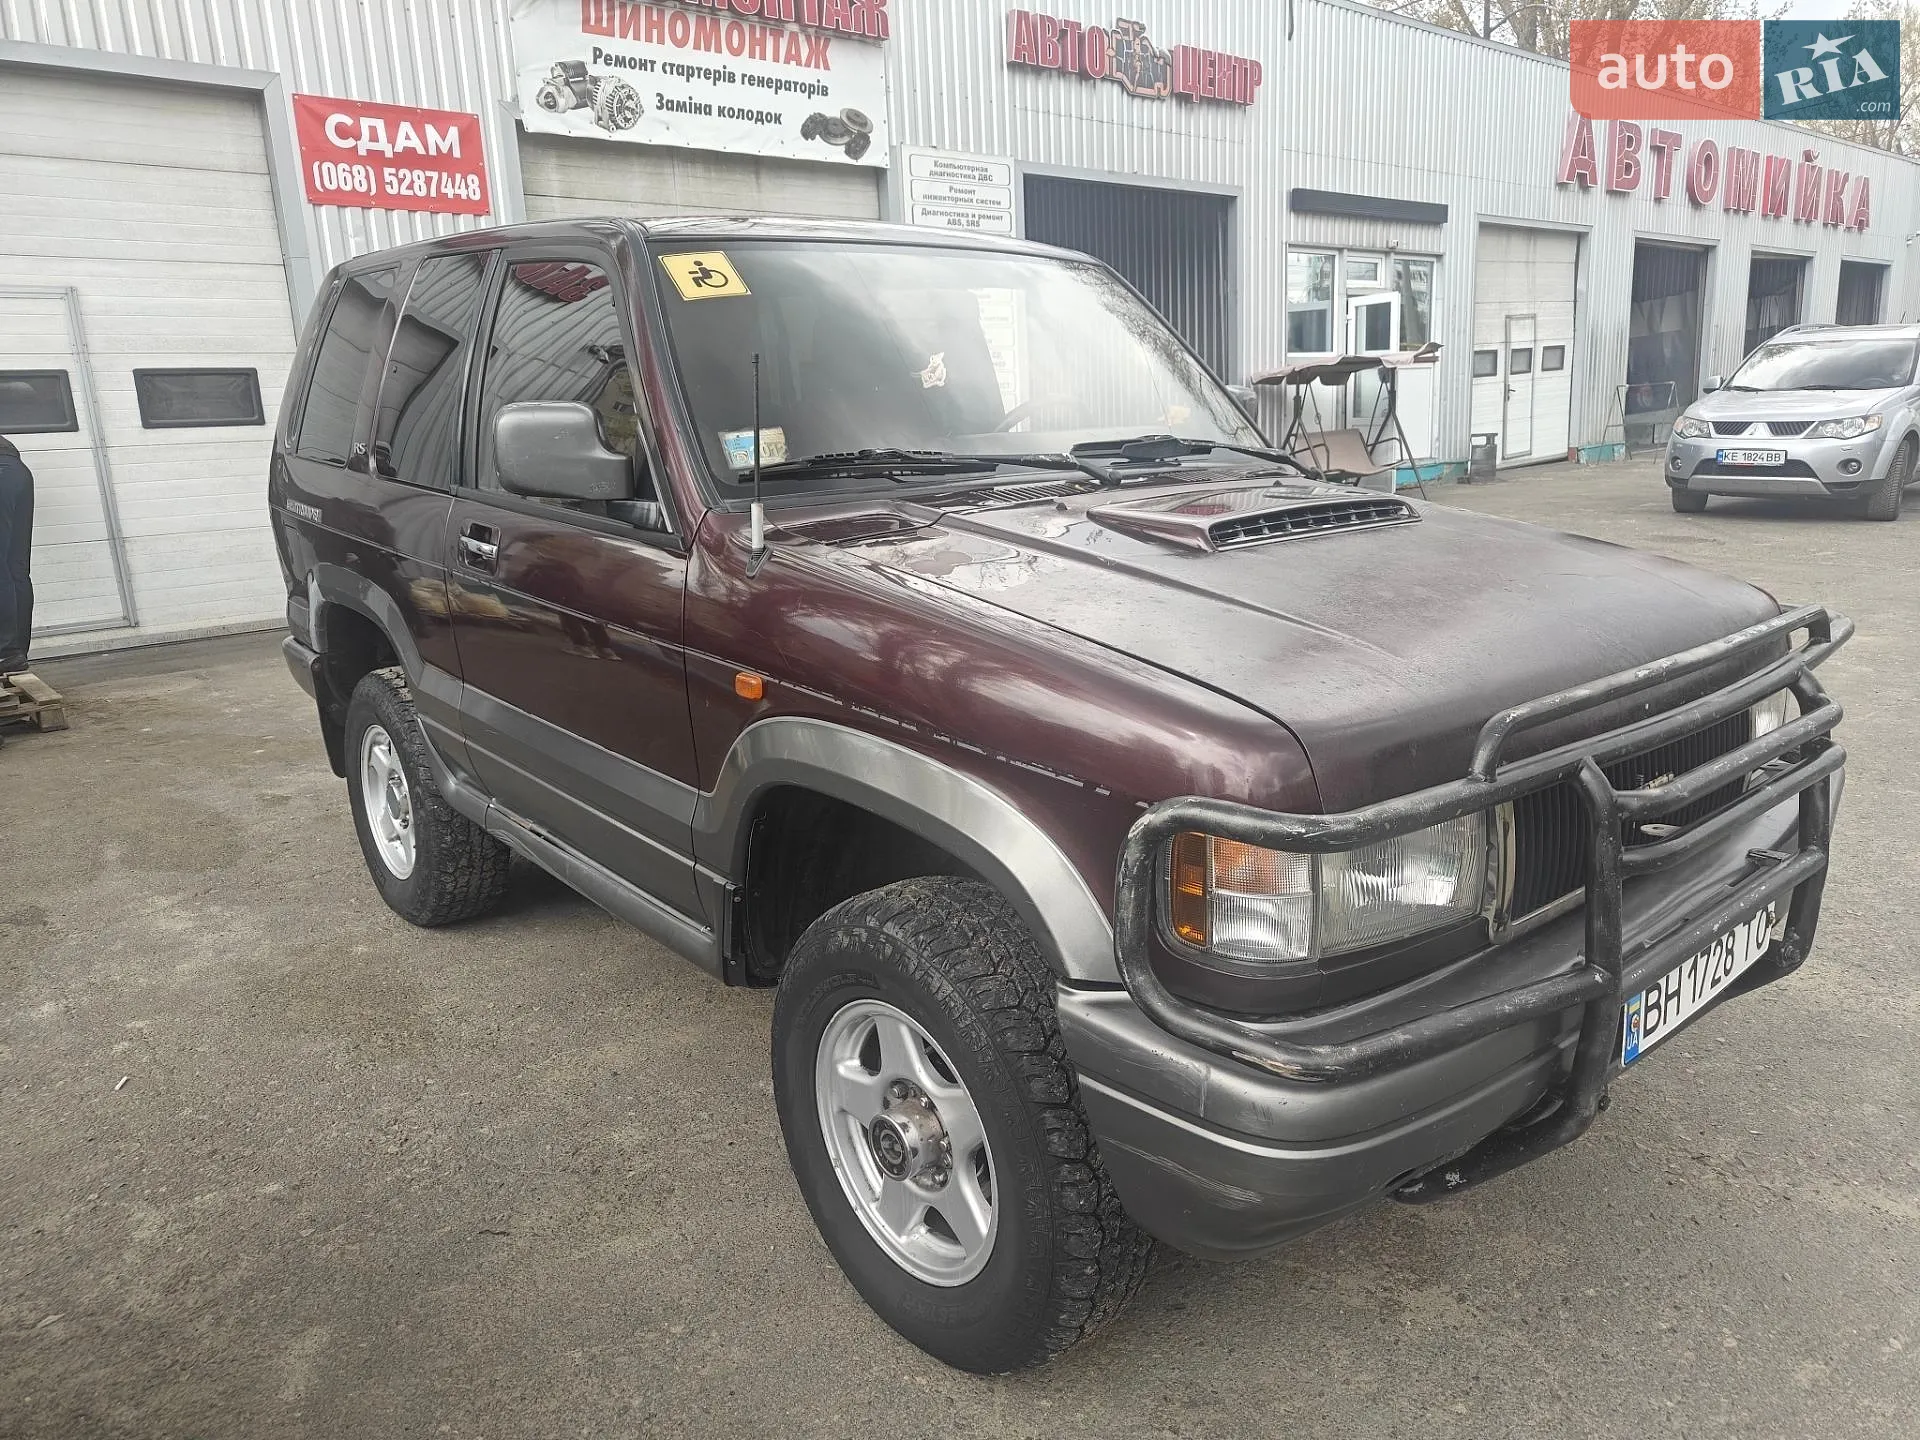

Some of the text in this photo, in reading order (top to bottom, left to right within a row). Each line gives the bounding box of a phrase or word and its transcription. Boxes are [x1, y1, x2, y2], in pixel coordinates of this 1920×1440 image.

[582, 0, 831, 71] ШИНОМОНТАЖ
[1007, 9, 1263, 105] АВТО ЦЕНТР
[592, 46, 829, 100] Ремонт стартерів генераторів
[655, 92, 783, 126] Заміна колодок
[324, 113, 461, 159] СДАМ
[312, 160, 482, 201] (068) 5287448
[977, 174, 993, 182] ДВС
[1557, 111, 1871, 231] АВТОМИЙКА
[921, 207, 970, 219] Диагностика
[1723, 451, 1781, 462] KE 1824 BB
[1643, 965, 1683, 1040] BH
[1687, 930, 1736, 1004] 1728
[1626, 1030, 1639, 1050] UA
